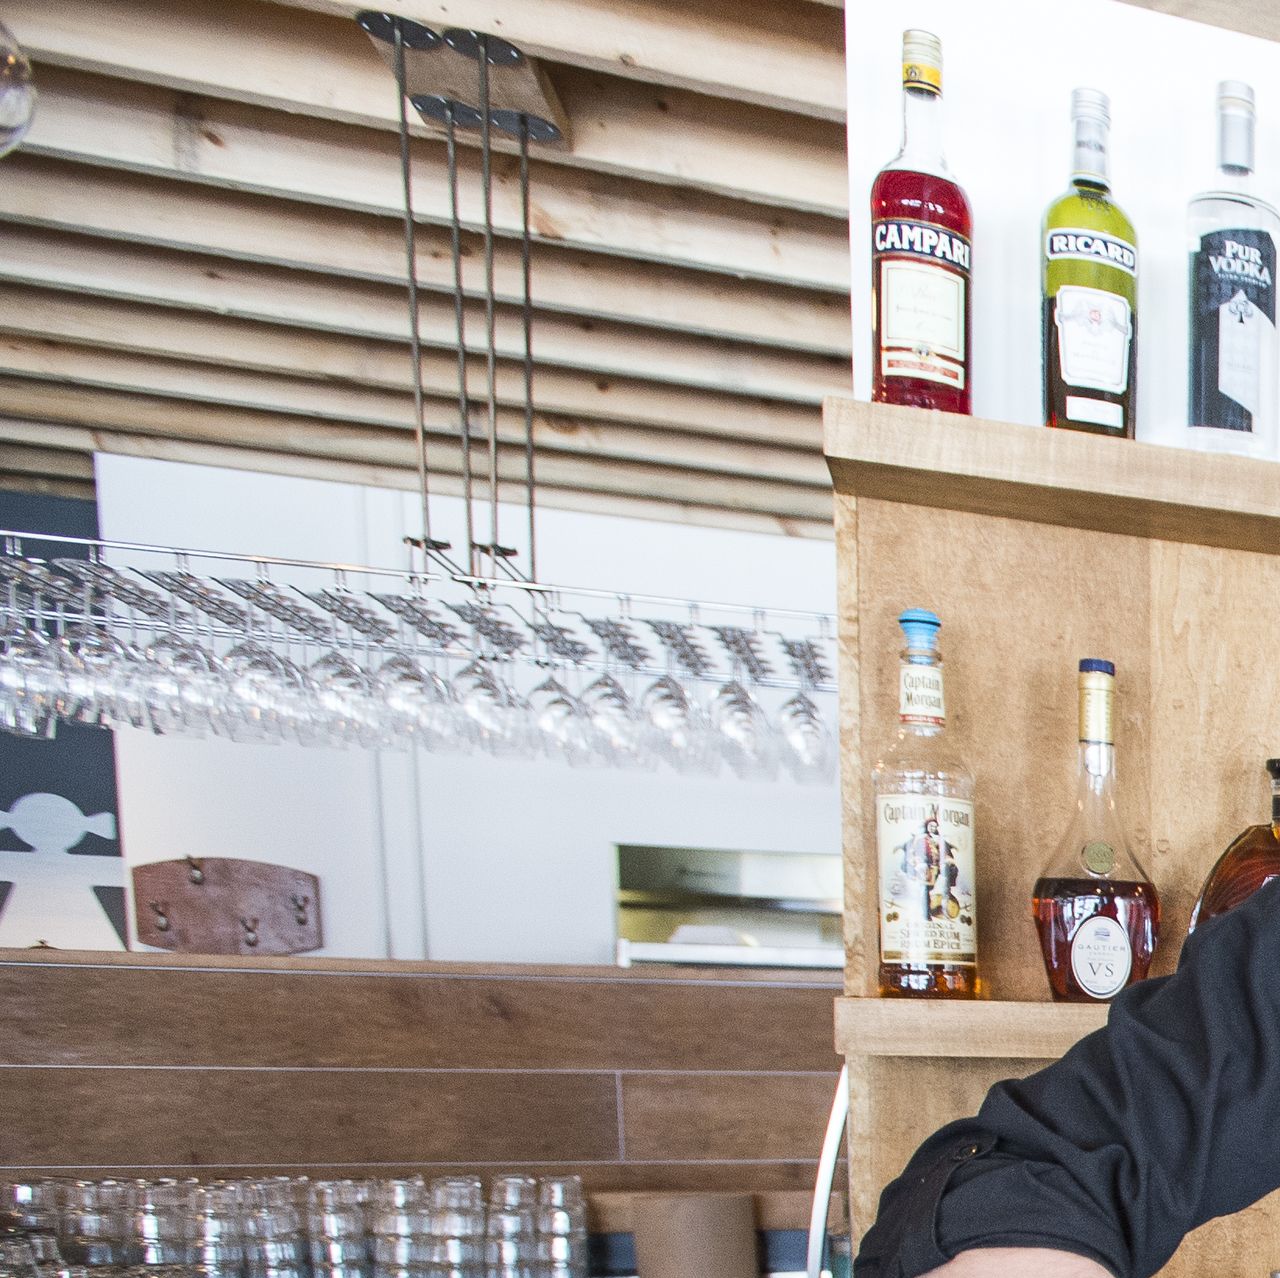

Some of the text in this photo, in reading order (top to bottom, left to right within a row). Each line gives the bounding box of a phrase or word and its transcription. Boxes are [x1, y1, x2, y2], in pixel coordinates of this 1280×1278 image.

[875, 223, 970, 270] CAMPARI
[1052, 234, 1135, 269] RICARD
[1224, 239, 1263, 266] PUR
[1208, 255, 1272, 287] VODKA
[903, 672, 941, 692] Captain
[905, 691, 942, 710] Morgan
[884, 802, 970, 828] Captain Morgan
